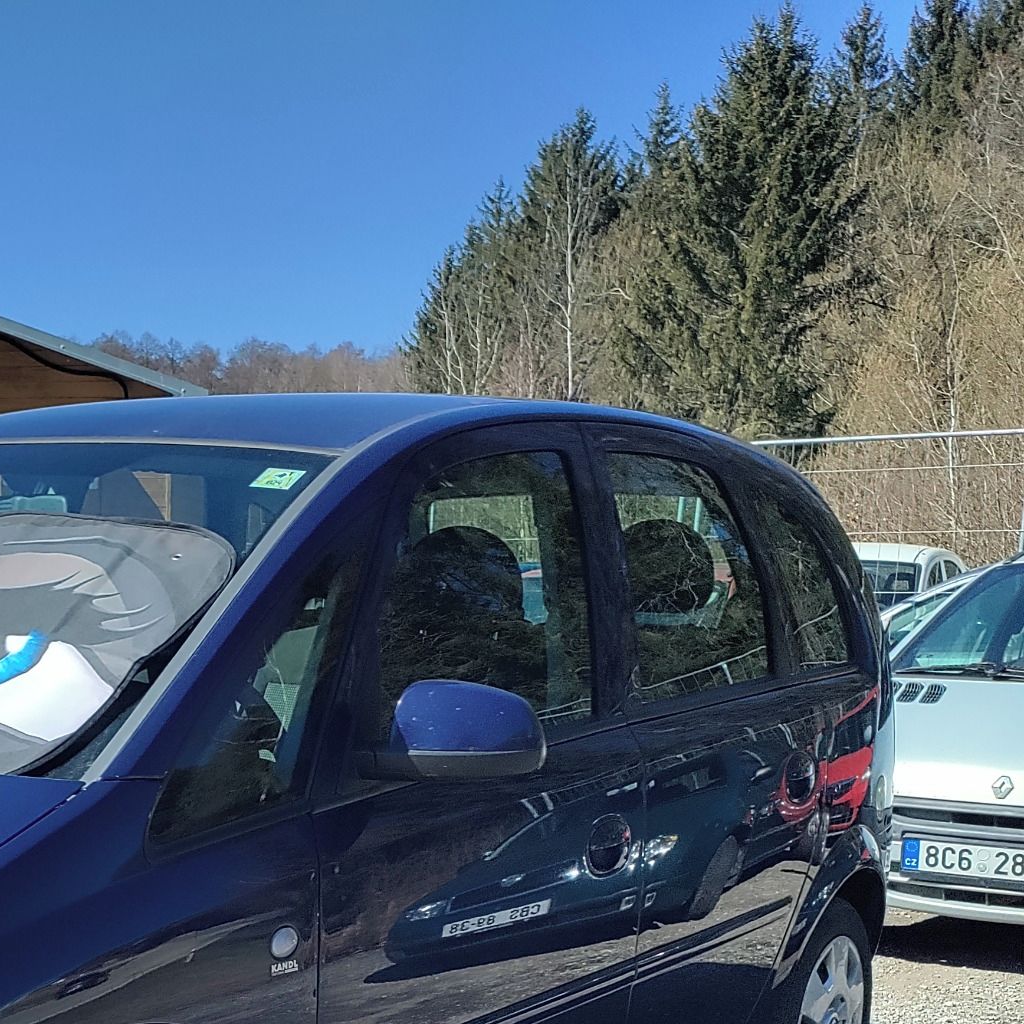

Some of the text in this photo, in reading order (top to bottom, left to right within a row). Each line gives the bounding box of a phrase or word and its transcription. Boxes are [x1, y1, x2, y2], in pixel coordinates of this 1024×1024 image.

[905, 845, 1024, 877] CZ 8C6 28
